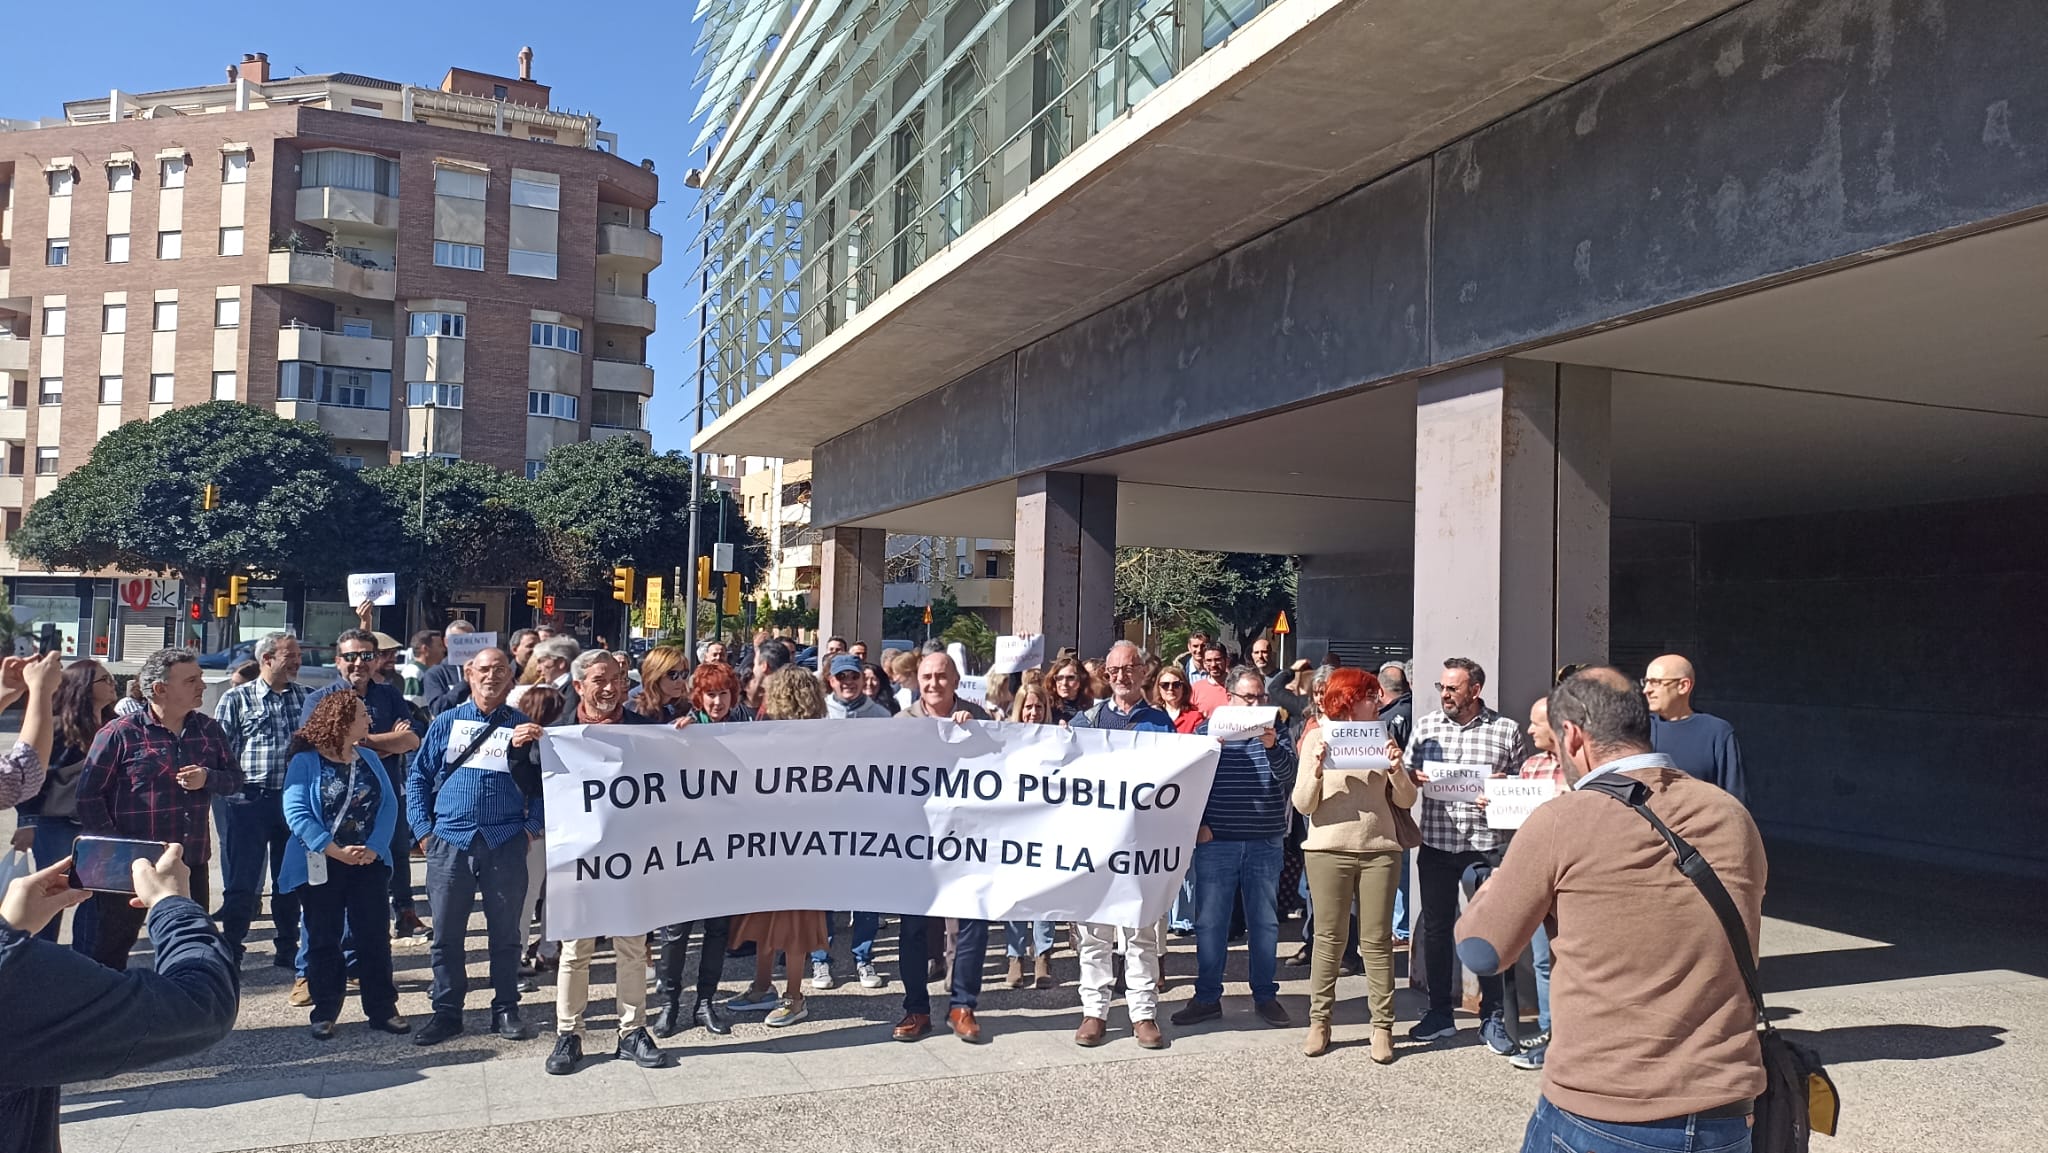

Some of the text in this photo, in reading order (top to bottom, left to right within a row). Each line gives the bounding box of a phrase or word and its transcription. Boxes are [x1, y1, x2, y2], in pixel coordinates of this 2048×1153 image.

[461, 727, 511, 740] GERNTE
[1331, 728, 1380, 738] GERENTE
[1431, 768, 1480, 779] GERENTE
[583, 765, 1181, 813] POR UN URBANISMO PÚBLICO
[1493, 786, 1543, 797] GERENTE
[576, 830, 1181, 881] NO A LA PRIVATIZACIÓN DE LA GMU
